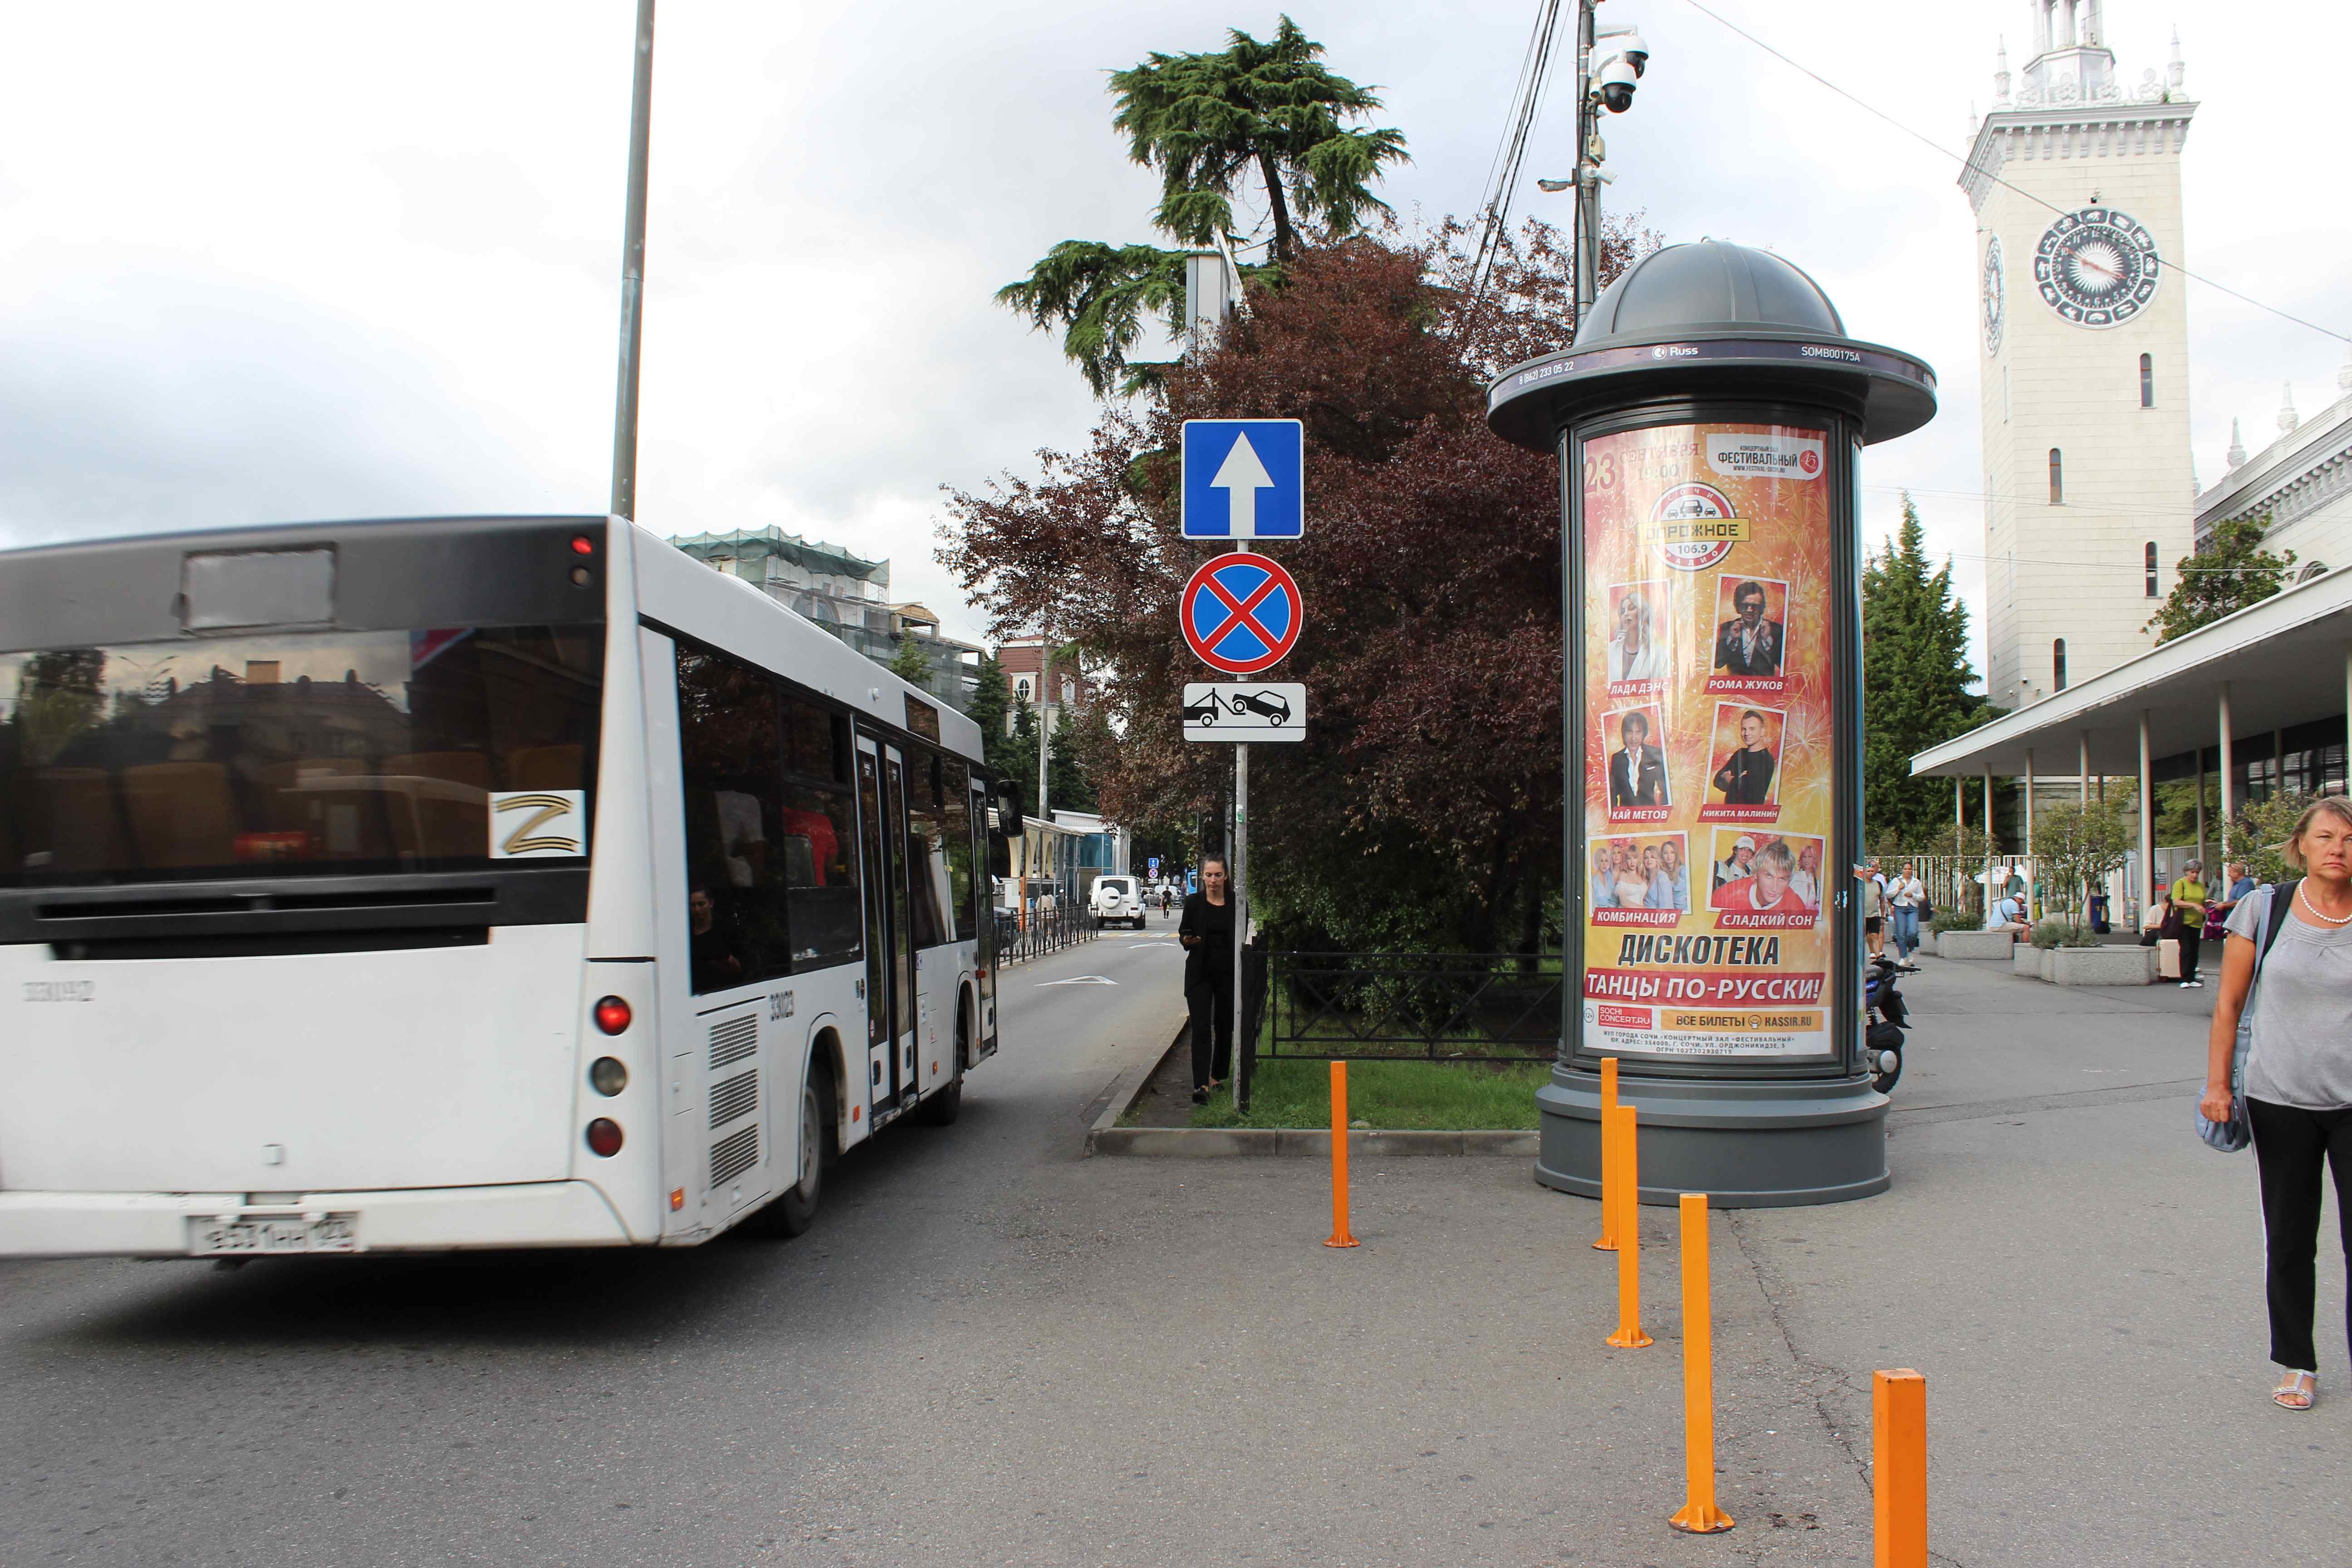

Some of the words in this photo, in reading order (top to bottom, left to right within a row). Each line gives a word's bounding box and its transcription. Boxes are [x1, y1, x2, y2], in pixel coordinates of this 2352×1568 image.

[1670, 347, 1699, 356] Russ
[1801, 346, 1861, 362] SOMB00175A
[1519, 376, 1524, 385] 8
[1524, 370, 1538, 384] (862)
[1539, 367, 1552, 378] 233
[1553, 363, 1563, 374] 05
[1564, 361, 1574, 372] 22
[1620, 443, 1700, 464] СЕНТЯБРЯ
[1718, 452, 1798, 467] ФЕСТИВАЛЬНЫЙ
[1584, 452, 1616, 494] 23
[1638, 464, 1679, 480] 19:00
[1677, 544, 1708, 554] 106.9
[1666, 550, 1719, 566] РАДИО
[1610, 684, 1637, 695] ЛАДА
[1638, 682, 1669, 695] ДЭНС
[1709, 680, 1743, 689] РОМА
[1744, 680, 1783, 690] ЖУКОВ
[1612, 809, 1631, 820] КАЙ
[1632, 810, 1668, 820] МЕТОВ
[1737, 810, 1778, 818] МАЛИНИН
[493, 794, 581, 855] Z
[1597, 911, 1676, 924] КОМБИНАЦИЯ
[1722, 912, 1786, 927] СЛАДКИЙ
[1788, 914, 1813, 926] СОН
[1617, 934, 1779, 966] ДИСКОТЕКА
[1588, 974, 1660, 1001] ТАНЦЫ
[1666, 978, 1820, 1000] ПО-РУССКИ!
[1600, 1007, 1622, 1015] SOCHI
[1600, 1014, 1650, 1024] CONCERT.RU
[1676, 1015, 1696, 1025] ВСЕ
[1699, 1016, 1745, 1027] БИЛЕТЫ
[1765, 1016, 1812, 1026] KASSIR.RU
